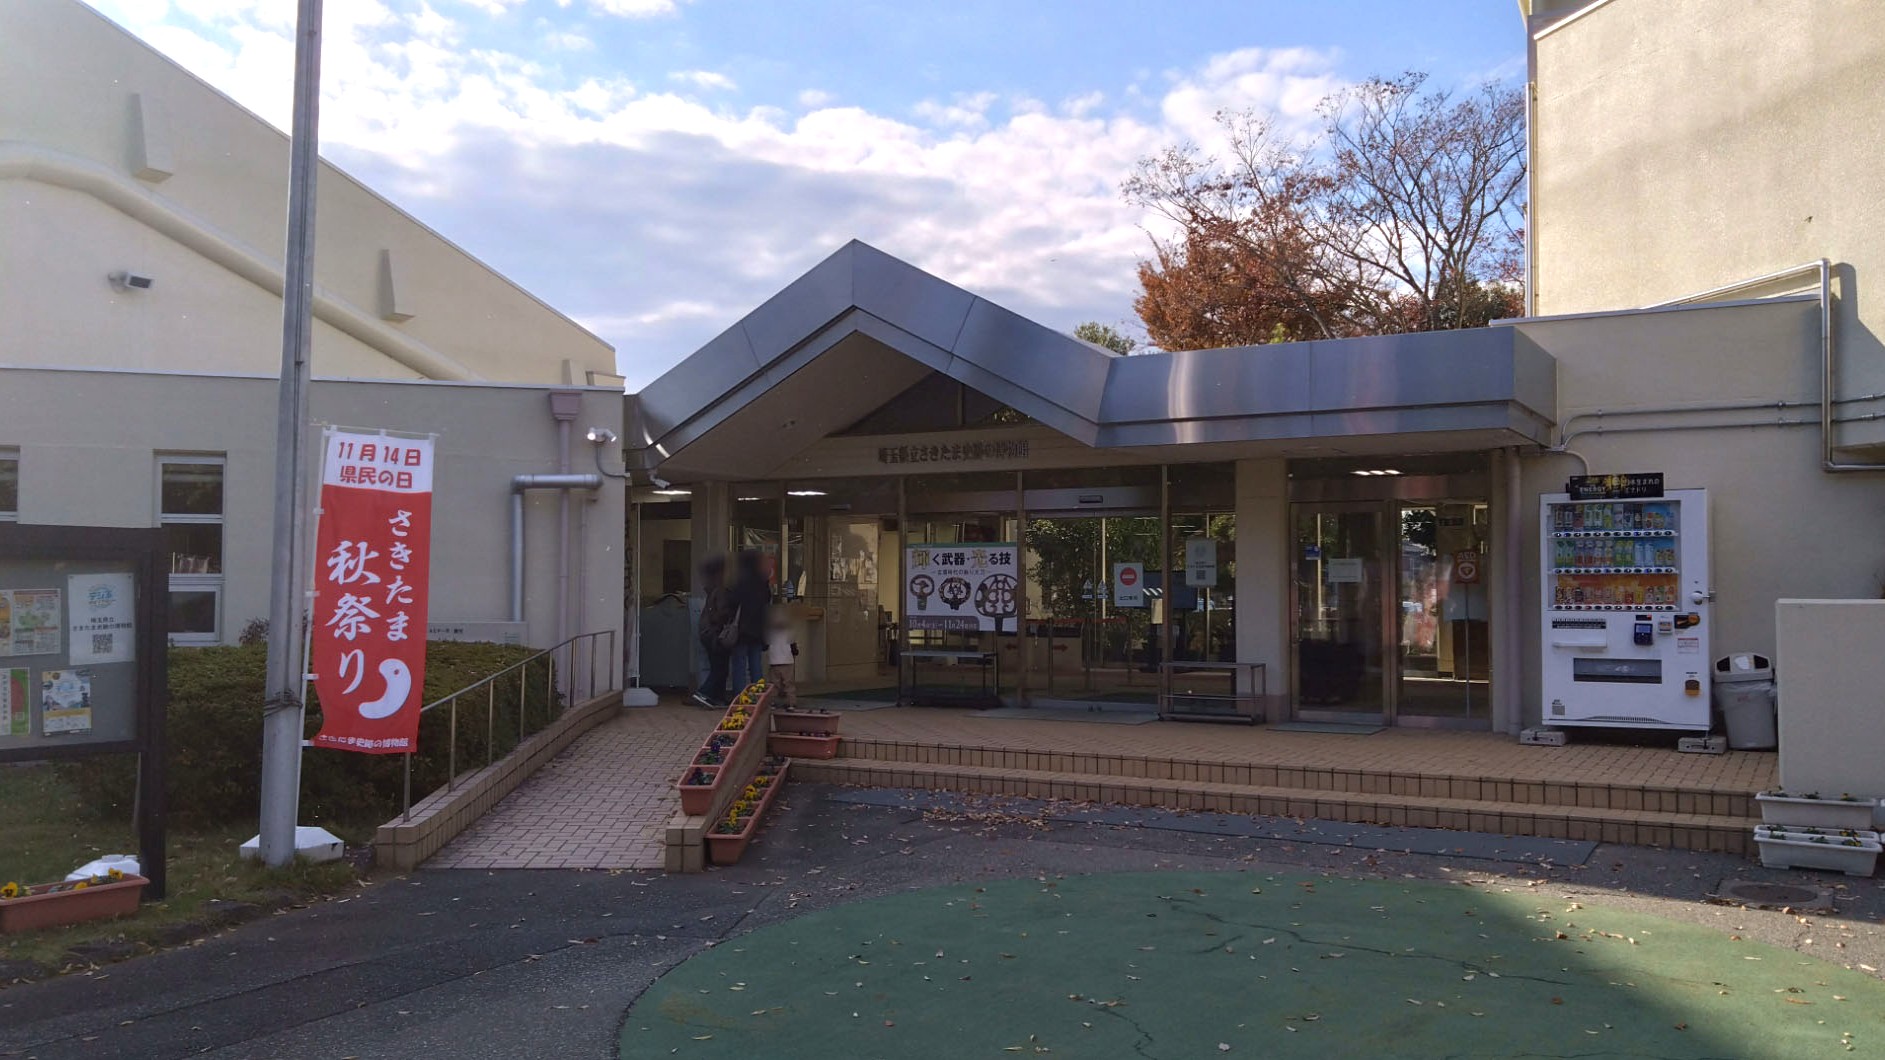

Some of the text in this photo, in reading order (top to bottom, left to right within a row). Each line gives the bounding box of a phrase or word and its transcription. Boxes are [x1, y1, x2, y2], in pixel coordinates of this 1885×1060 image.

[337, 442, 421, 466] 11月14日
[340, 465, 413, 489] 県民の日
[386, 509, 414, 642] さきたま
[325, 540, 381, 695] 秋祭り
